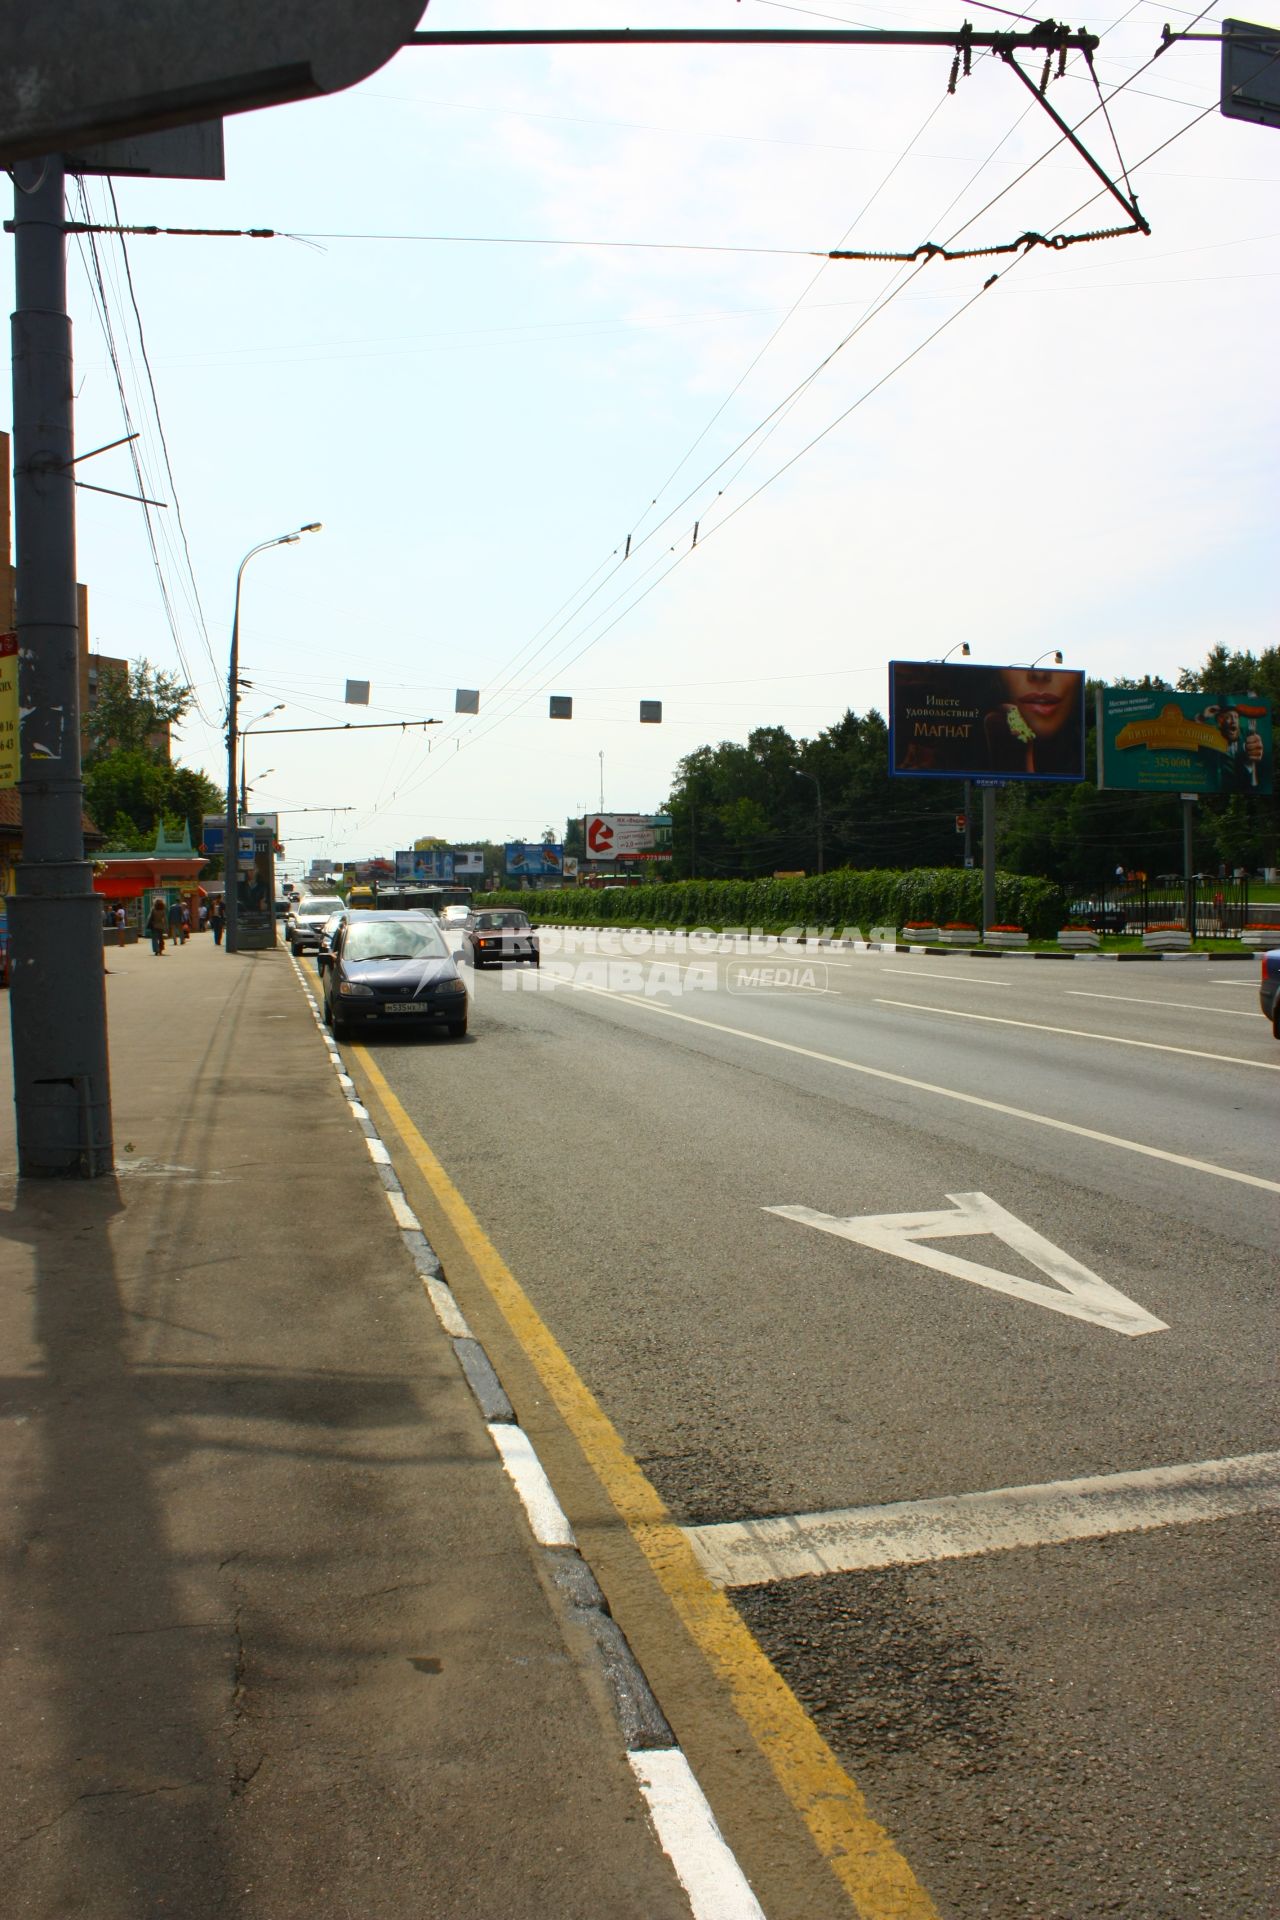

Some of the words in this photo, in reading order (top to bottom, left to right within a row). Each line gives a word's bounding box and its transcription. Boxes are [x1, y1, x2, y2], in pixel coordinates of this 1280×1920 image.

[926, 695, 960, 706] Ищете
[906, 707, 980, 719] удовольствия?
[913, 723, 972, 738] МАГНАТ
